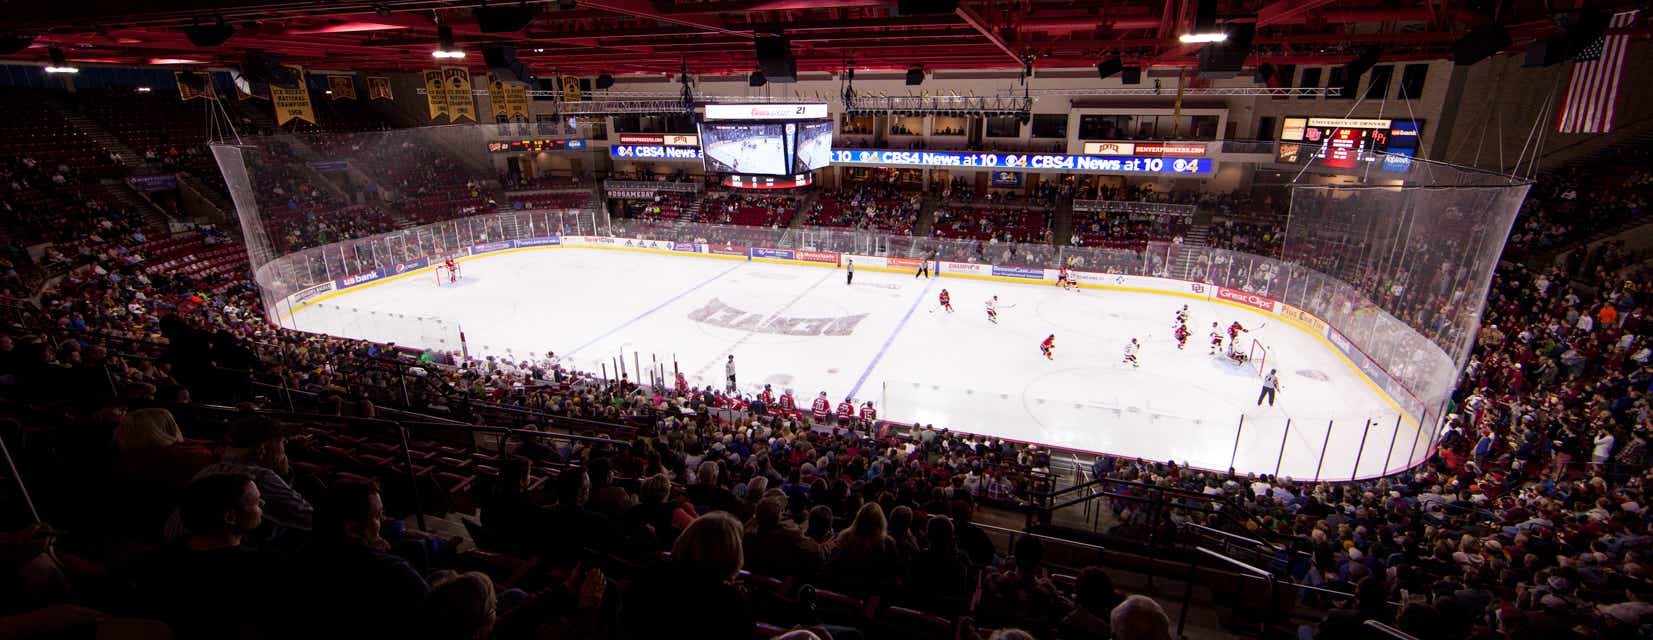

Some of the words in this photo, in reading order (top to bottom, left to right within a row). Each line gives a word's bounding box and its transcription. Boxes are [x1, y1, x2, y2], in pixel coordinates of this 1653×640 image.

[635, 146, 665, 158] CBS4
[666, 146, 697, 159] News
[836, 150, 852, 163] 10
[882, 151, 920, 165] CBS4
[922, 152, 961, 166] News
[963, 154, 978, 166] at
[980, 154, 998, 167] 10
[1031, 155, 1075, 169] CBS4
[1077, 156, 1121, 171] News
[1123, 158, 1141, 172] at
[1143, 158, 1163, 172] 10
[1221, 288, 1248, 302] Great
[1248, 295, 1272, 308] Clips
